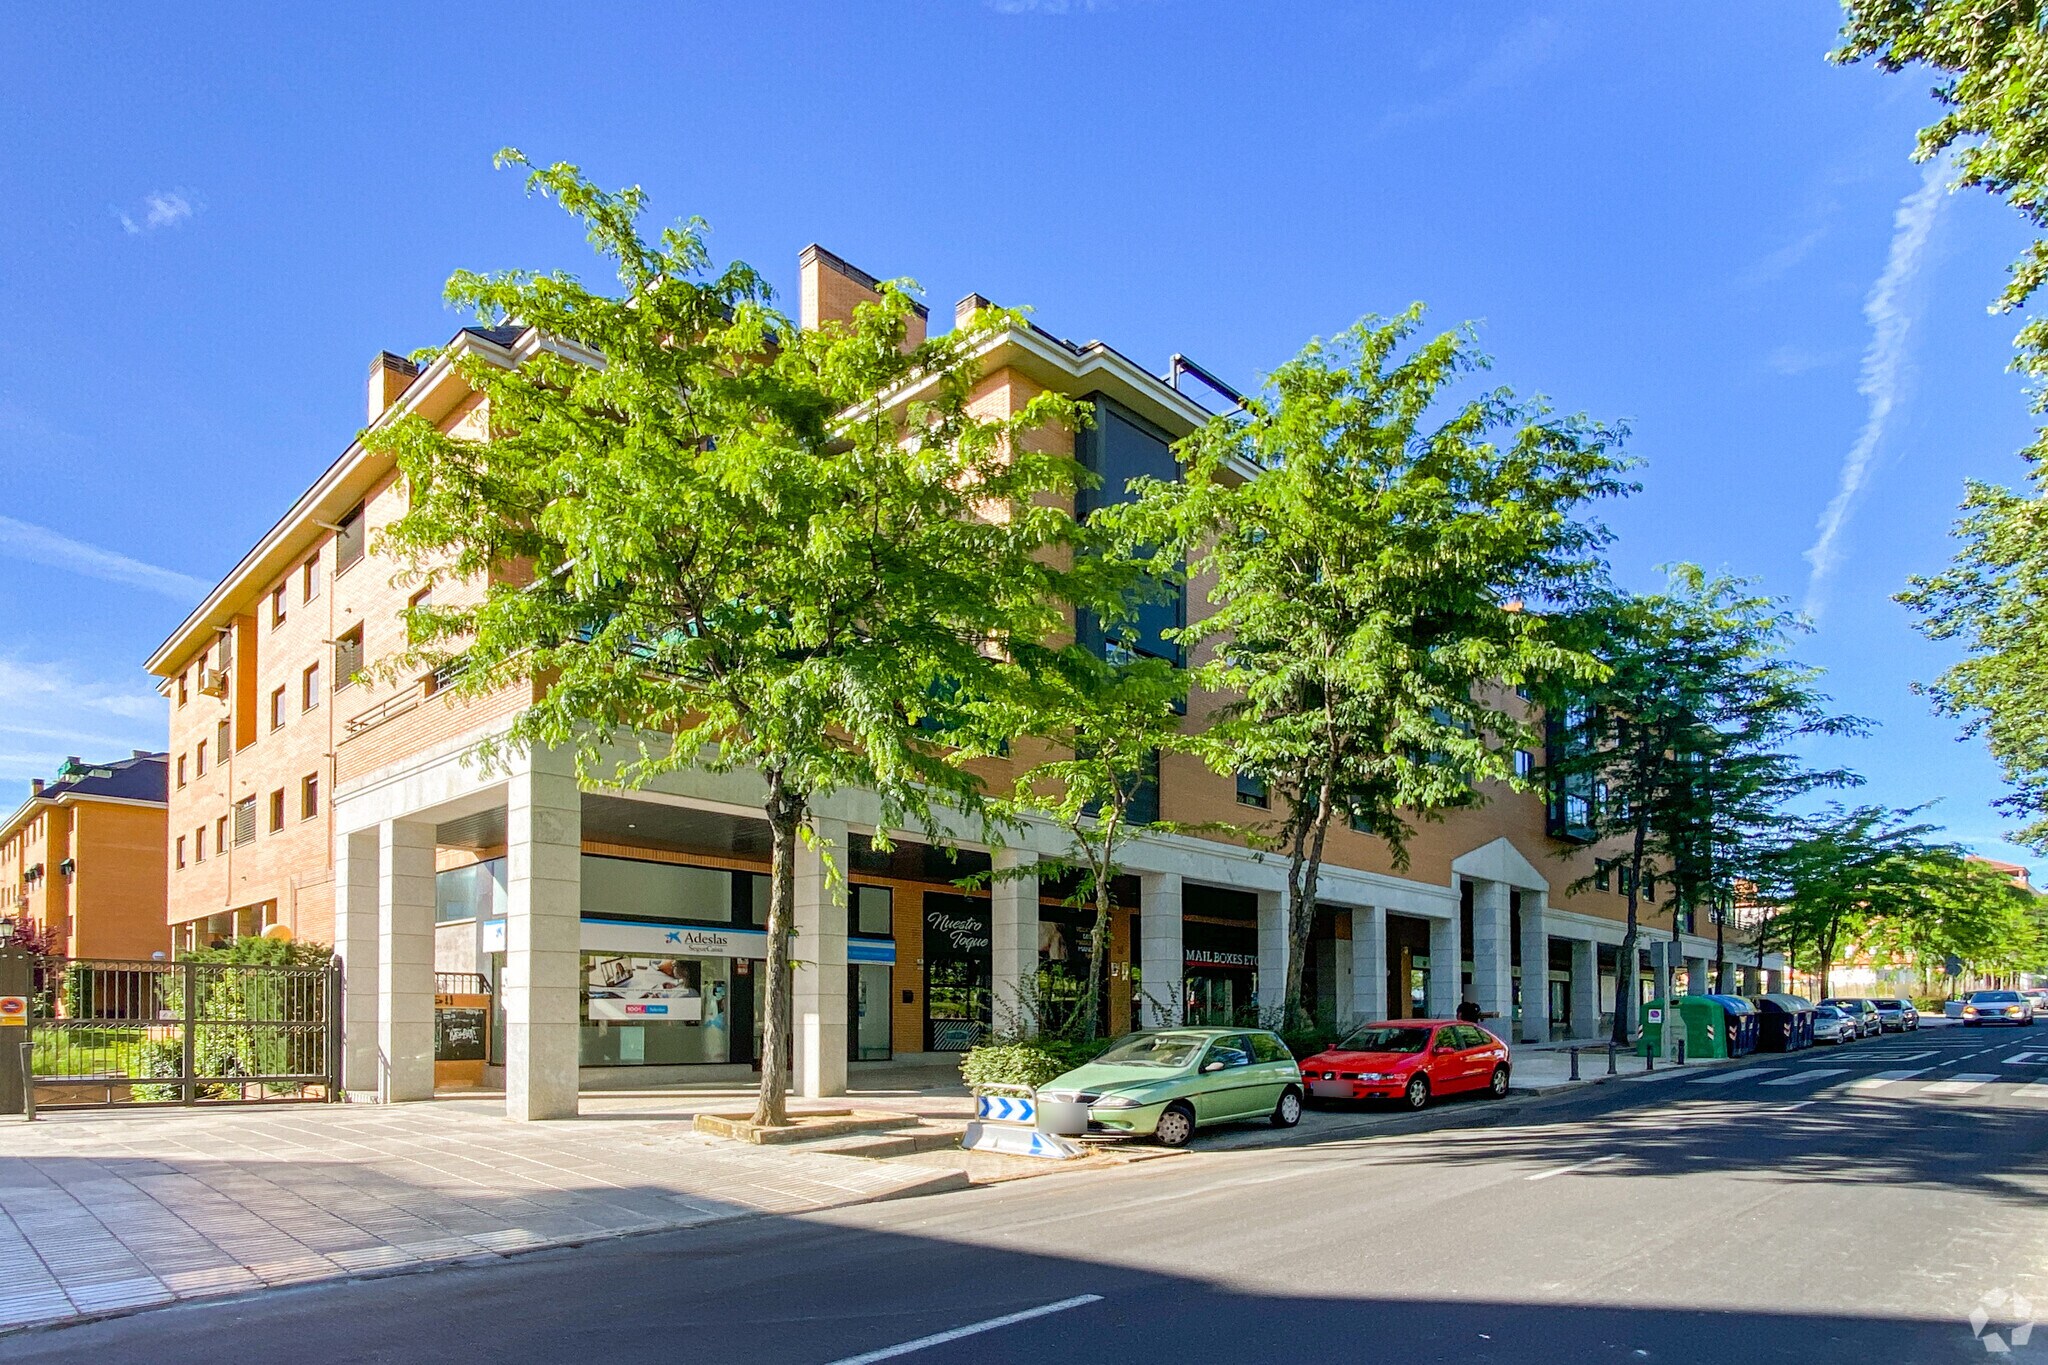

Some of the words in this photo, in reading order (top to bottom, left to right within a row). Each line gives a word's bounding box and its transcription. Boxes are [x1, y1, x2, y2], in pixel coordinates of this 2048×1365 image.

[928, 912, 982, 931] Nuestro
[684, 932, 728, 945] Adeslas
[950, 930, 988, 952] Toque
[1186, 949, 1213, 962] MAIL
[1214, 952, 1242, 965] BOXES
